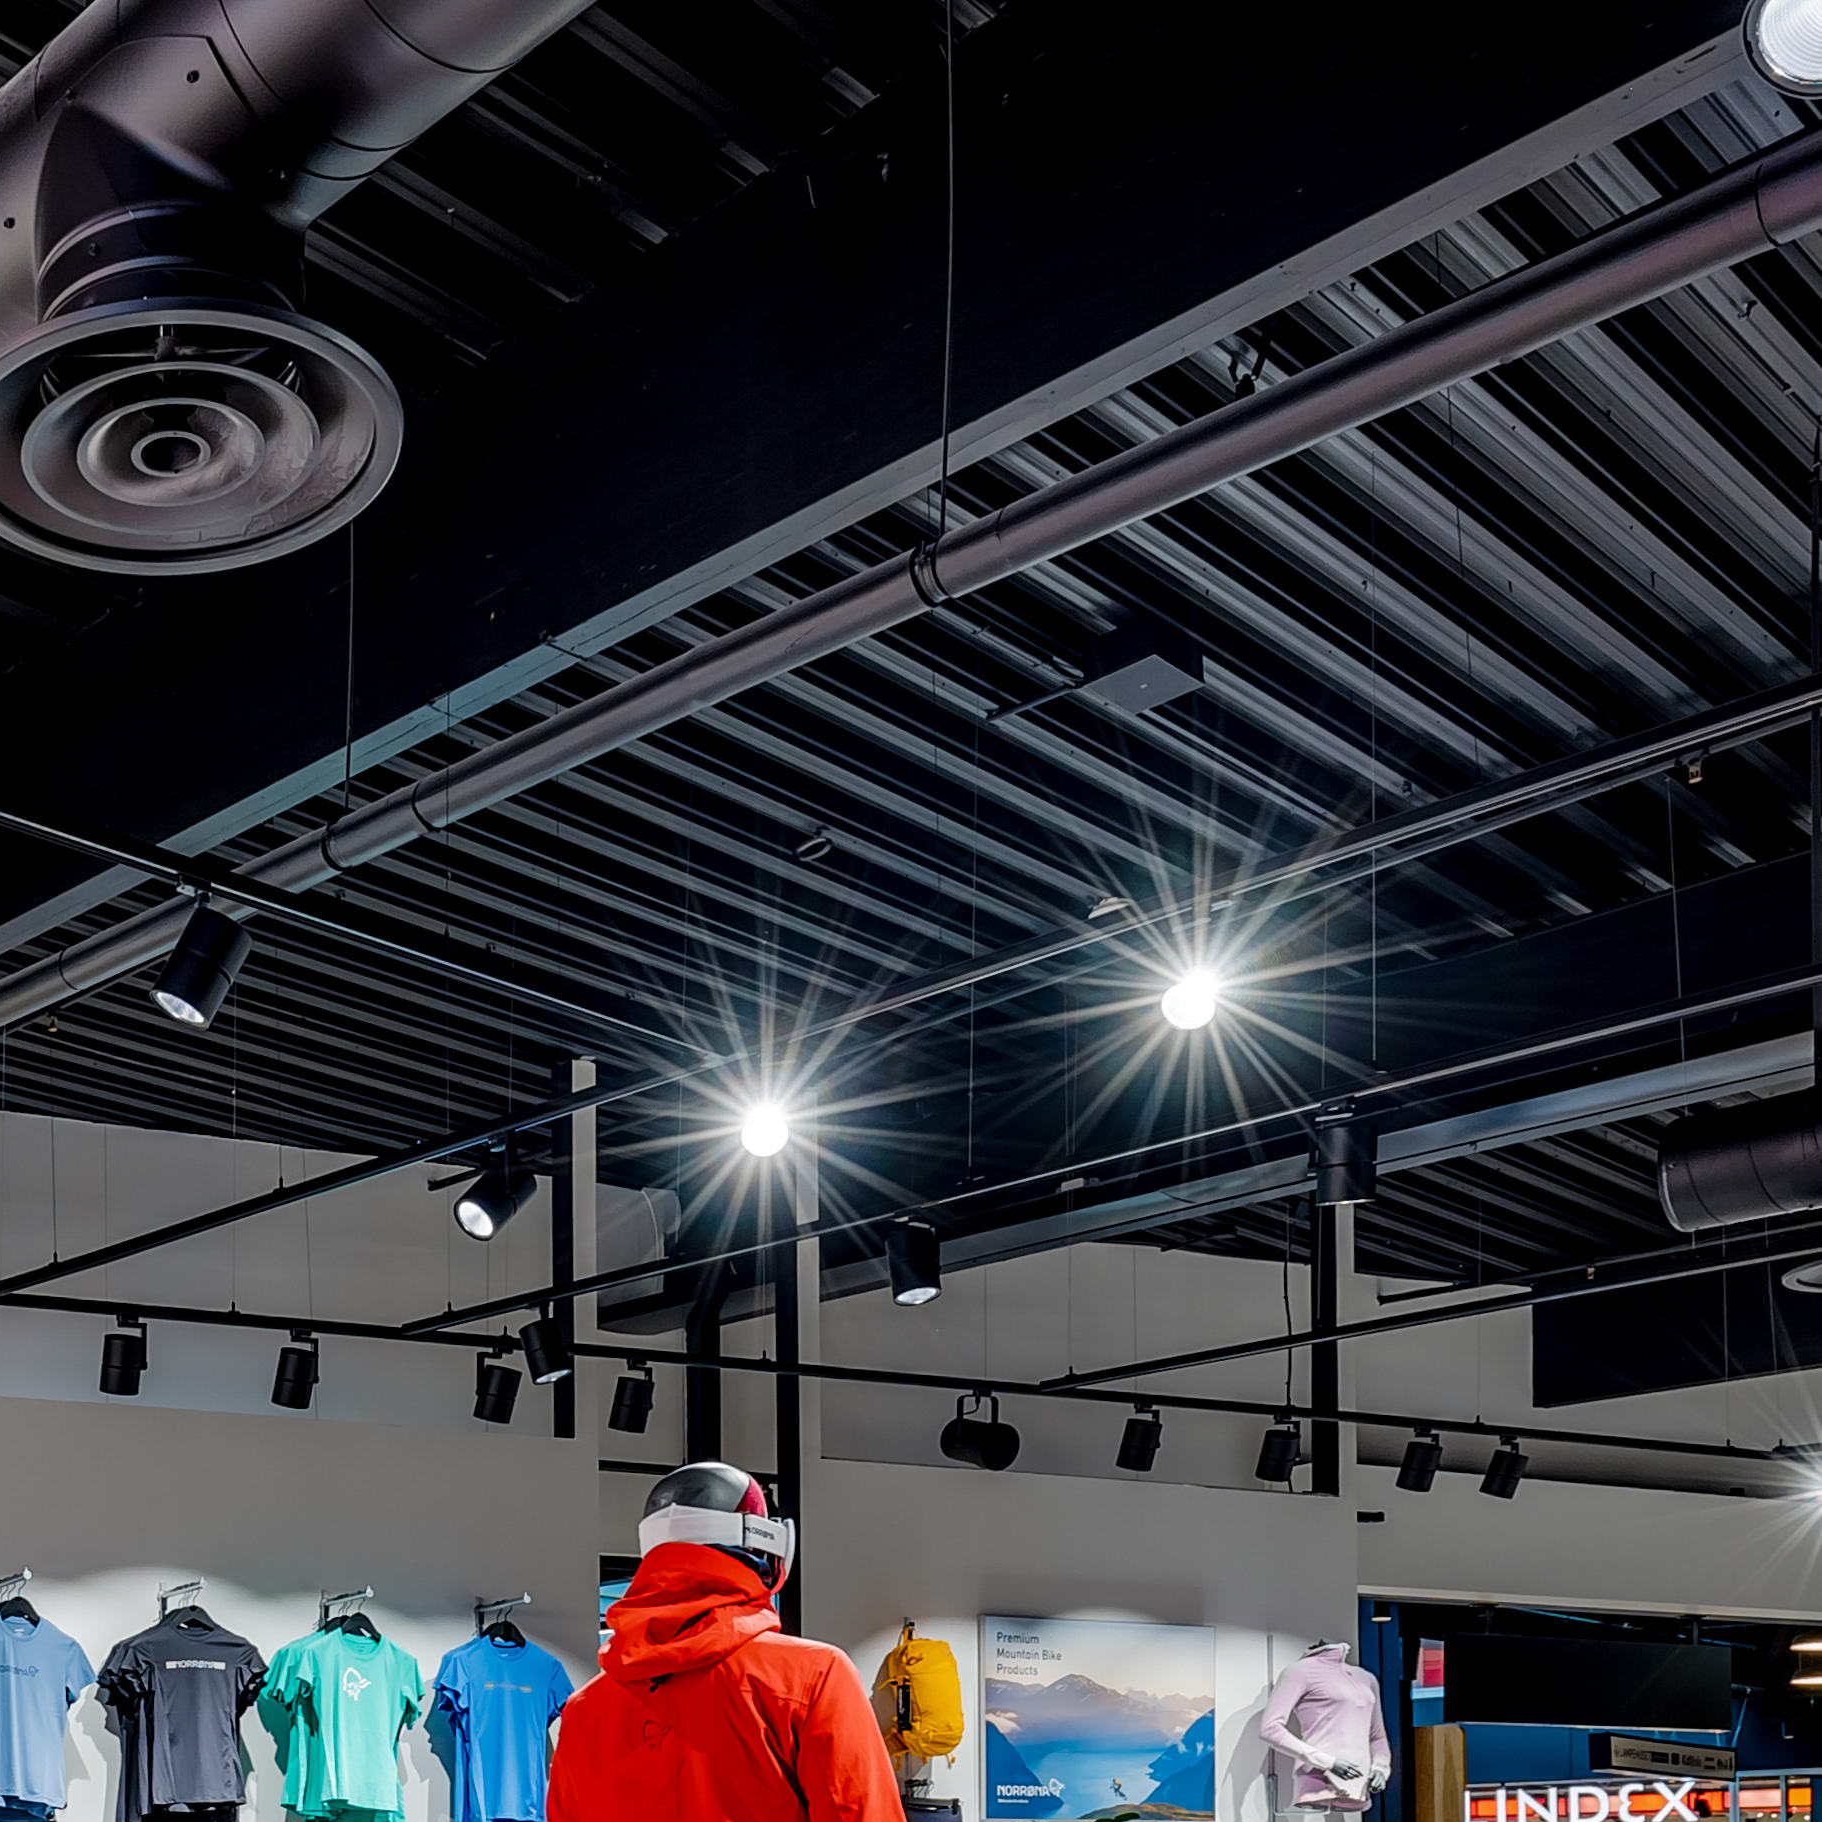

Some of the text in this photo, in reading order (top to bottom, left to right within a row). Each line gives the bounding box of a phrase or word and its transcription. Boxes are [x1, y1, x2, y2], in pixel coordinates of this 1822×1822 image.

[996, 1631, 1040, 1644] Premium
[996, 1648, 1062, 1661] Mountain Bike
[996, 1663, 1038, 1675] Products
[996, 1785, 1051, 1797] NORRØNA
